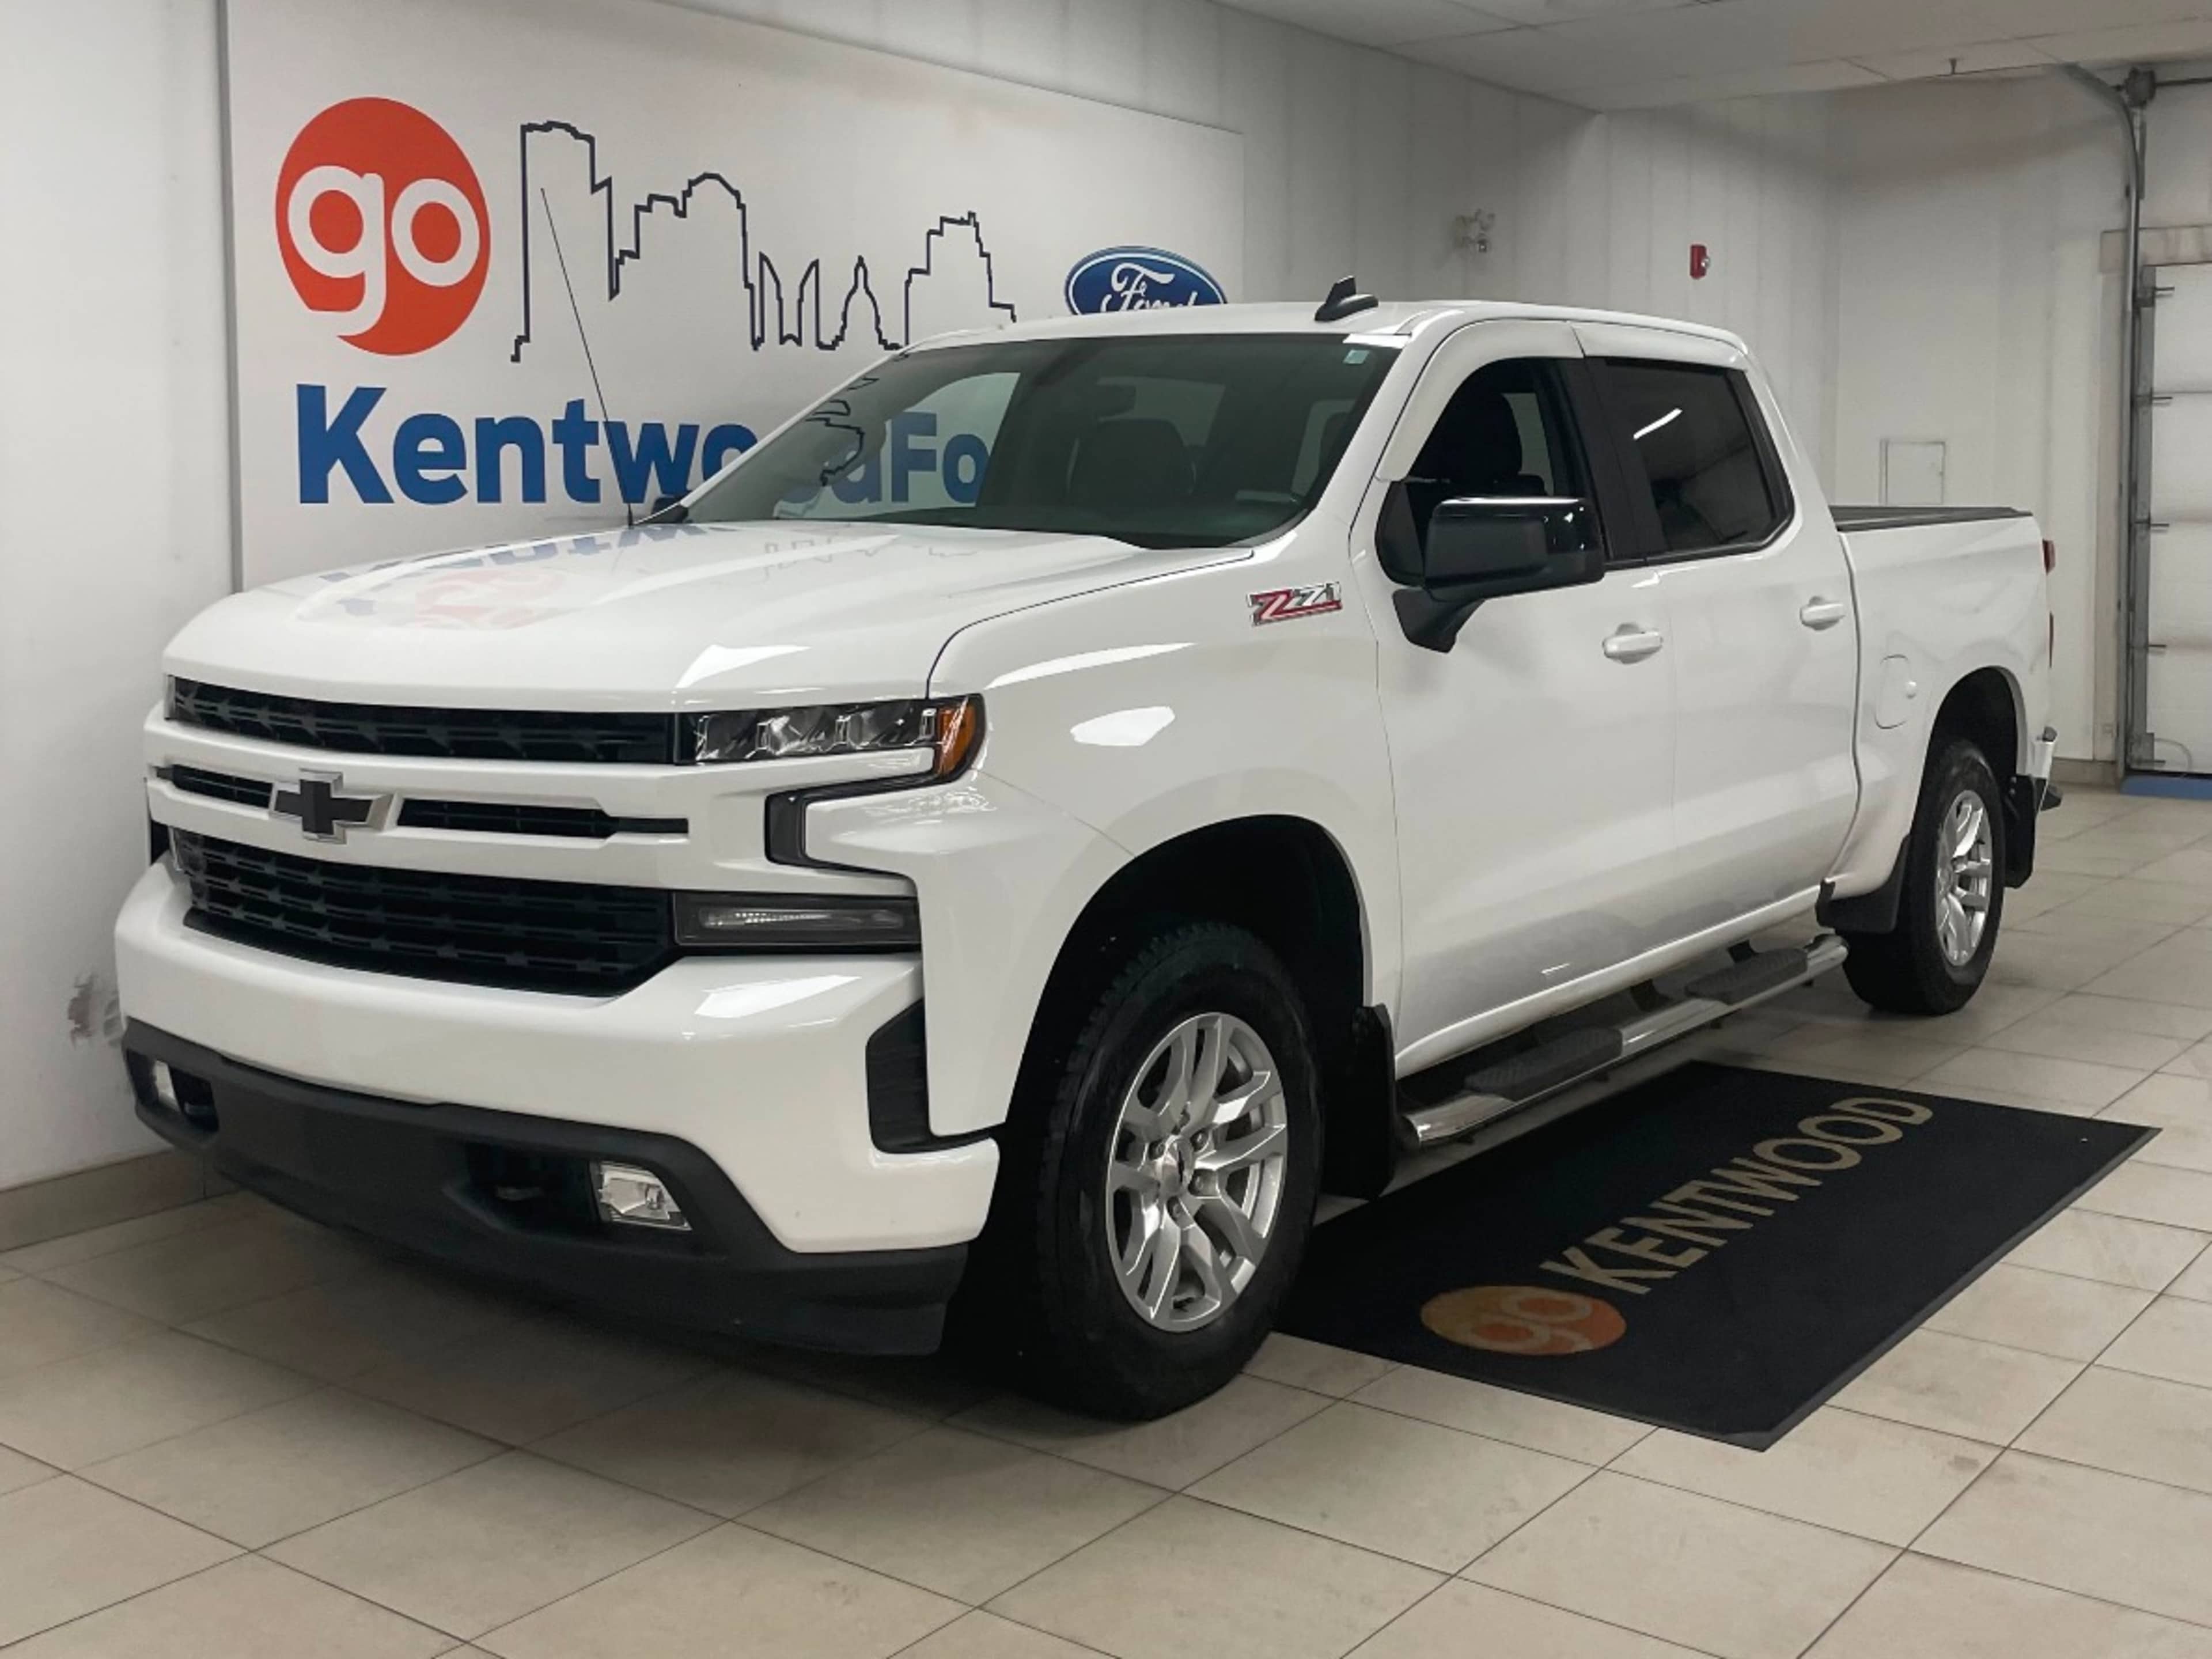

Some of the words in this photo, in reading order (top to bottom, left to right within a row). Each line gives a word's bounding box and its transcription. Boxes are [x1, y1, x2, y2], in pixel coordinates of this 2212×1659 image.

[287, 164, 480, 338] go
[1247, 581, 1342, 626] Z71
[1539, 1097, 1934, 1295] KENTWOOD
